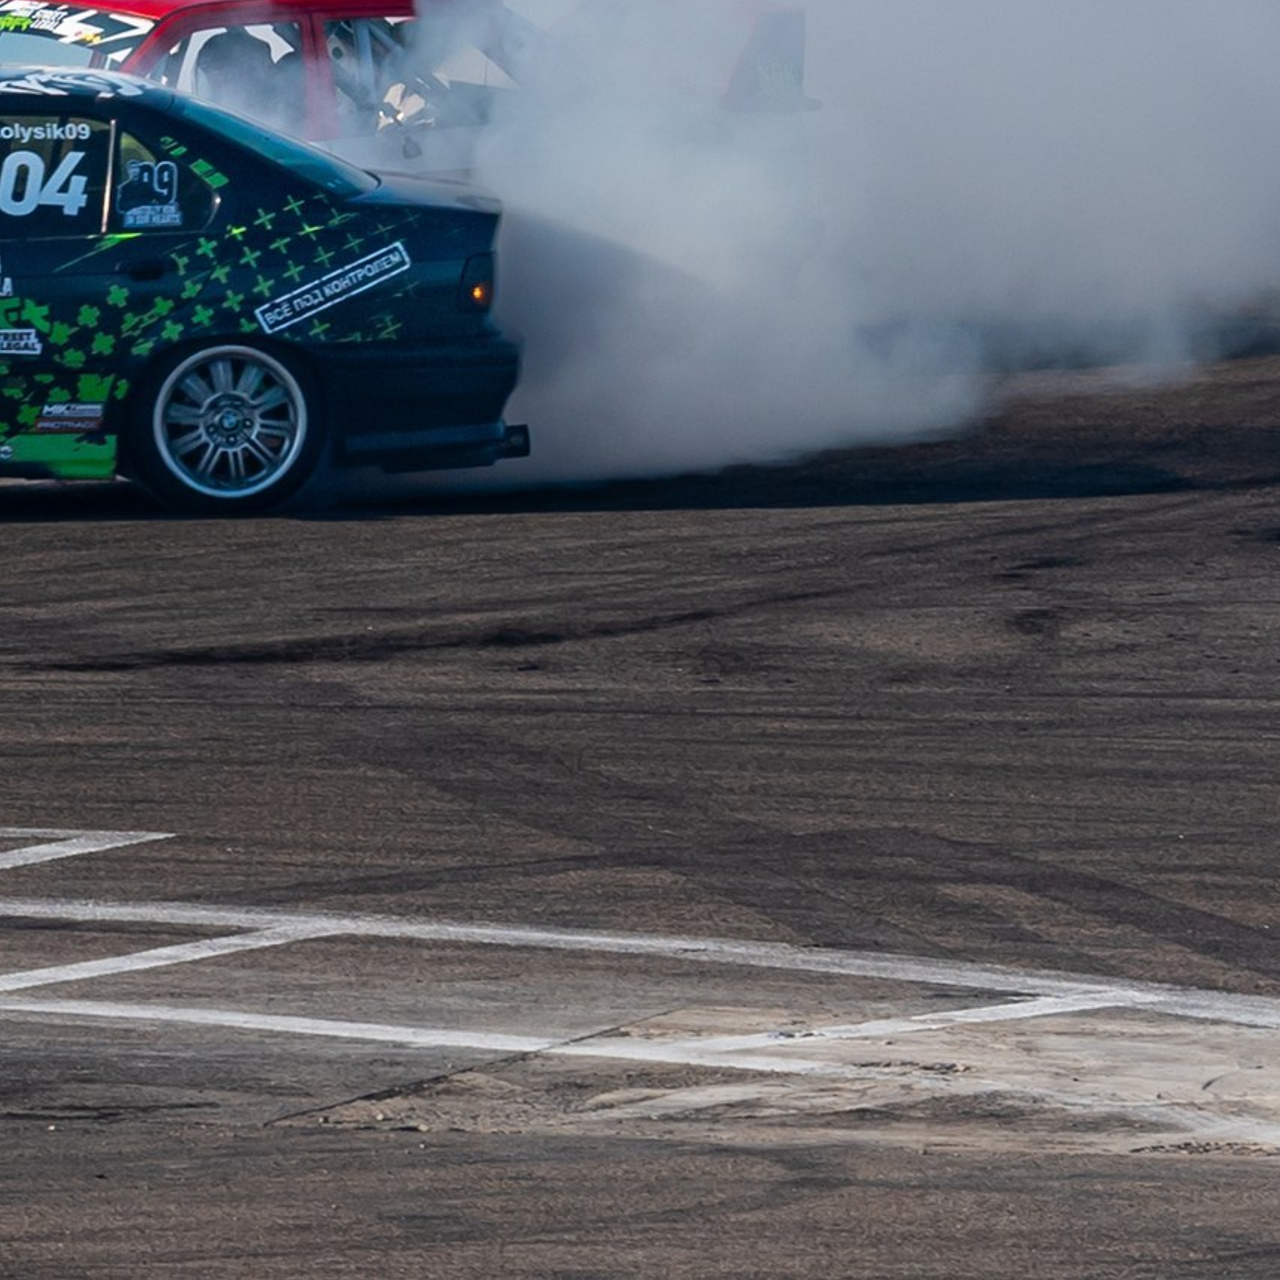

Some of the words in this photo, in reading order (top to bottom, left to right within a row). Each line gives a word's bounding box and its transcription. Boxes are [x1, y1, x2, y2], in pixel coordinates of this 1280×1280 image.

[264, 301, 294, 325] ВСЁ
[293, 289, 325, 311] ПОД
[0, 341, 38, 352] LEGAL
